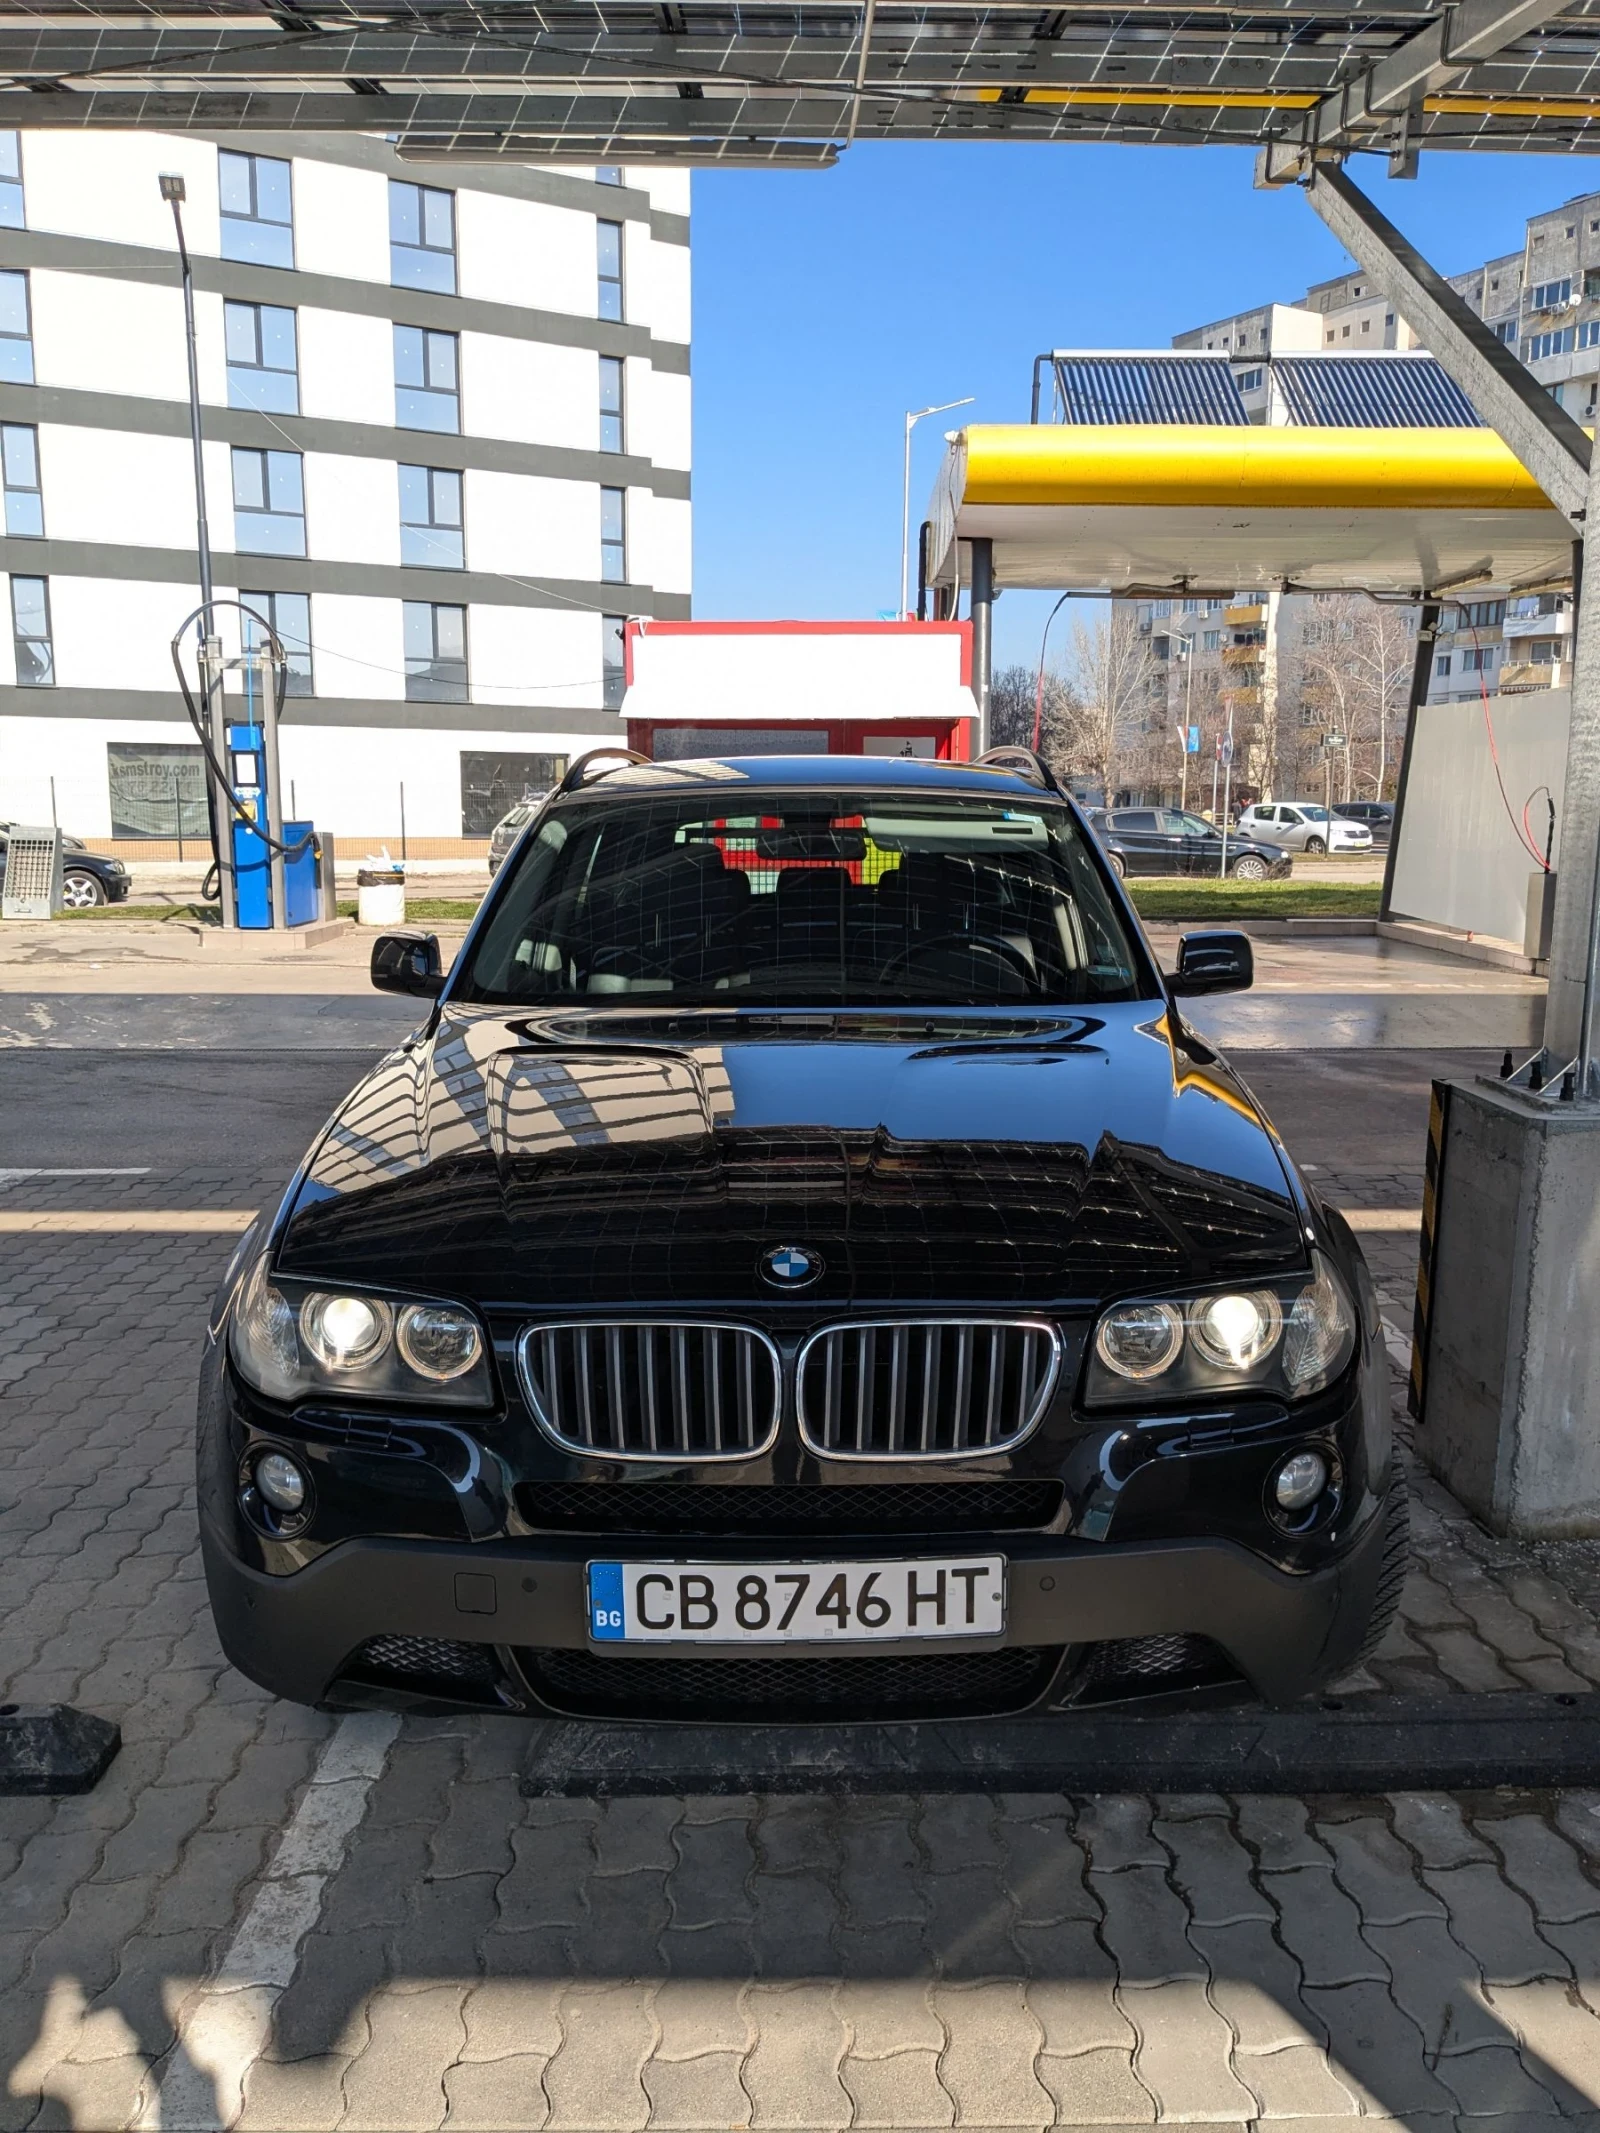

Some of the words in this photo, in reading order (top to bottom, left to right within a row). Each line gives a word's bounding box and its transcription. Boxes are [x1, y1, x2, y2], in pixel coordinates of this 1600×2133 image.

[596, 1610, 621, 1627] BG
[636, 1573, 719, 1630] CB
[735, 1571, 892, 1631] 8746
[907, 1567, 990, 1627] HT
